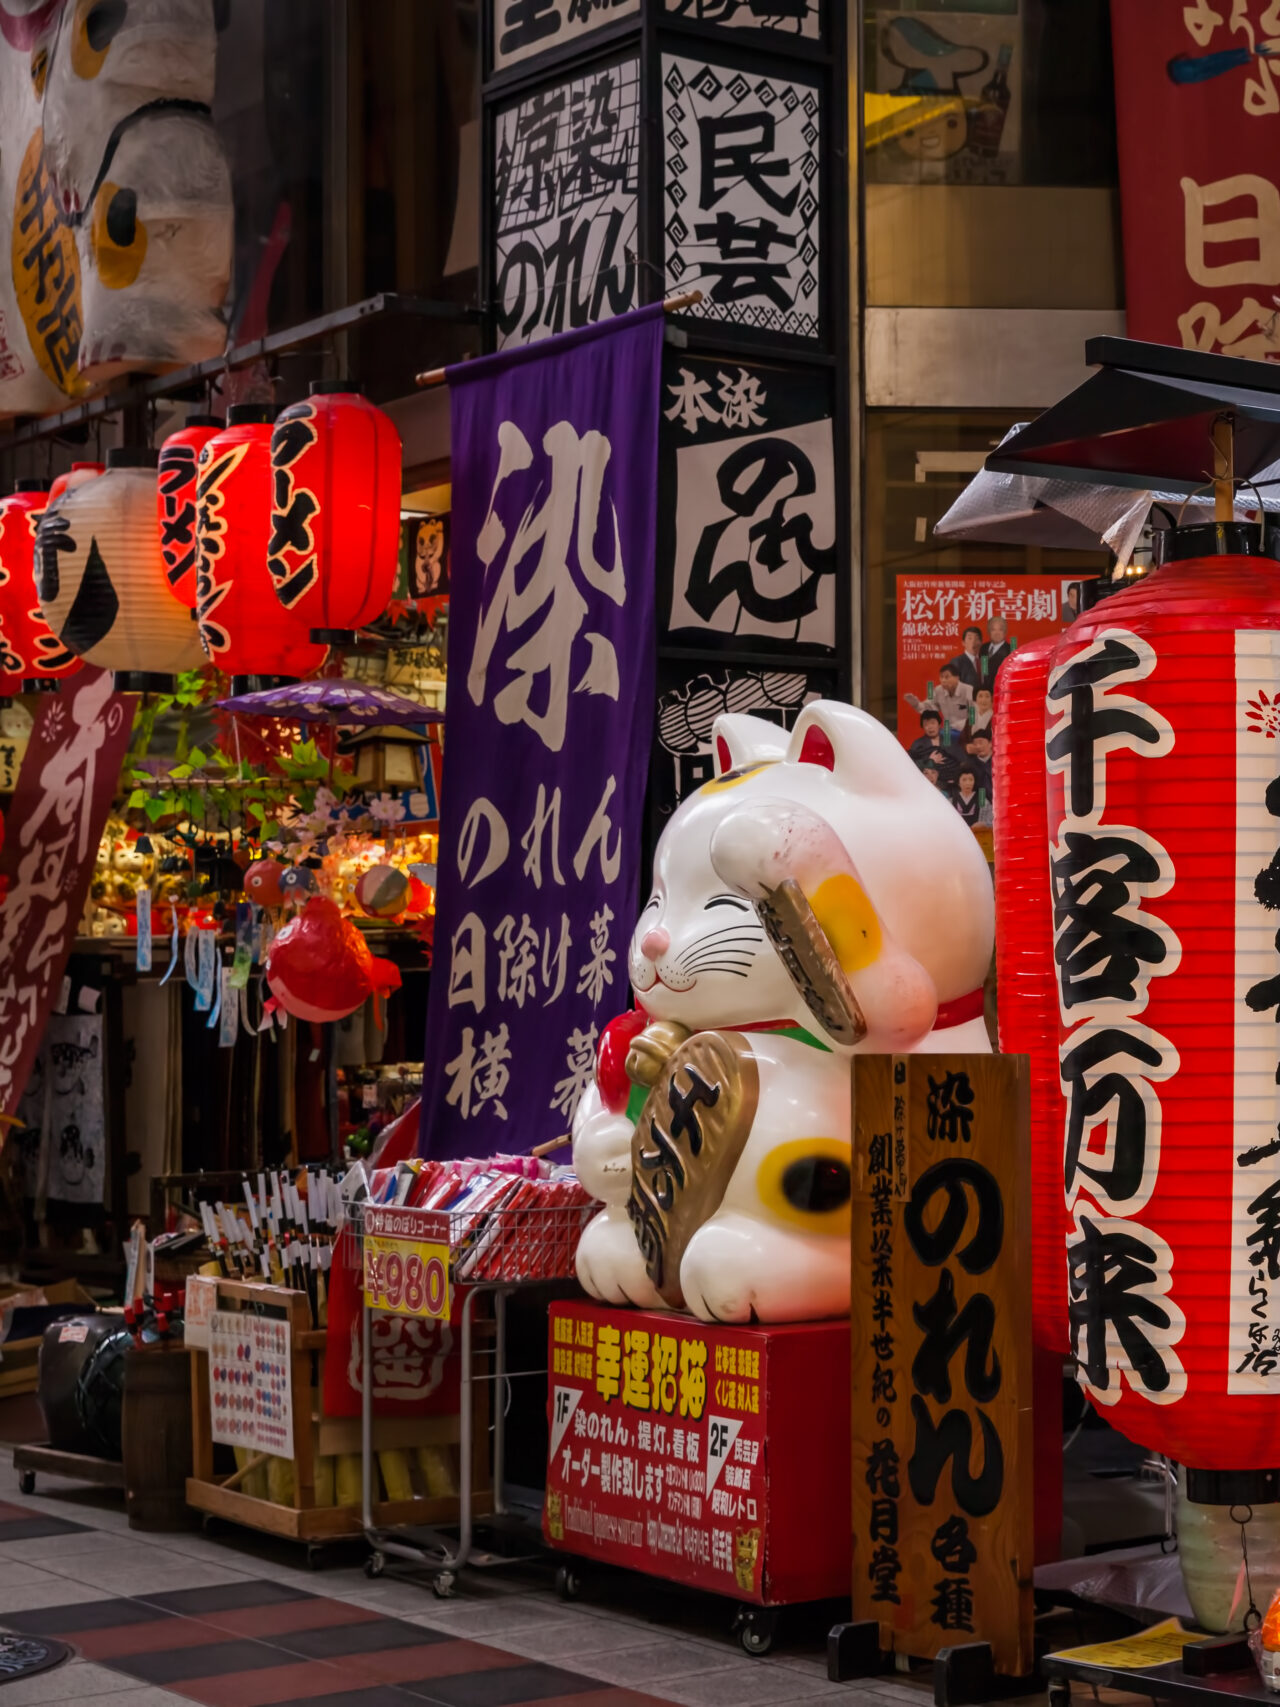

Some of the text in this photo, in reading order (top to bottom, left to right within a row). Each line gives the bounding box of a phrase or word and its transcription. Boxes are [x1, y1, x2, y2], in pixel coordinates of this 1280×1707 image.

[694, 111, 801, 314] 民芸
[497, 206, 636, 340] のれん
[663, 367, 768, 434] 本染
[158, 445, 197, 586] ラーメン
[266, 402, 322, 610] ラーメン
[466, 420, 627, 752] 染
[901, 588, 1058, 621] 松竹新喜劇
[457, 774, 622, 889] のれん
[448, 902, 618, 1015] 日除け幕
[1045, 630, 1188, 1405] 千客万来
[365, 1249, 447, 1315] ¥980
[556, 1391, 571, 1424] 1F
[710, 1421, 729, 1458] 2F
[734, 1437, 760, 1465] 民芸品
[561, 1445, 664, 1505] オーダー製作致します
[712, 1488, 758, 1521] 昭和レトロ
